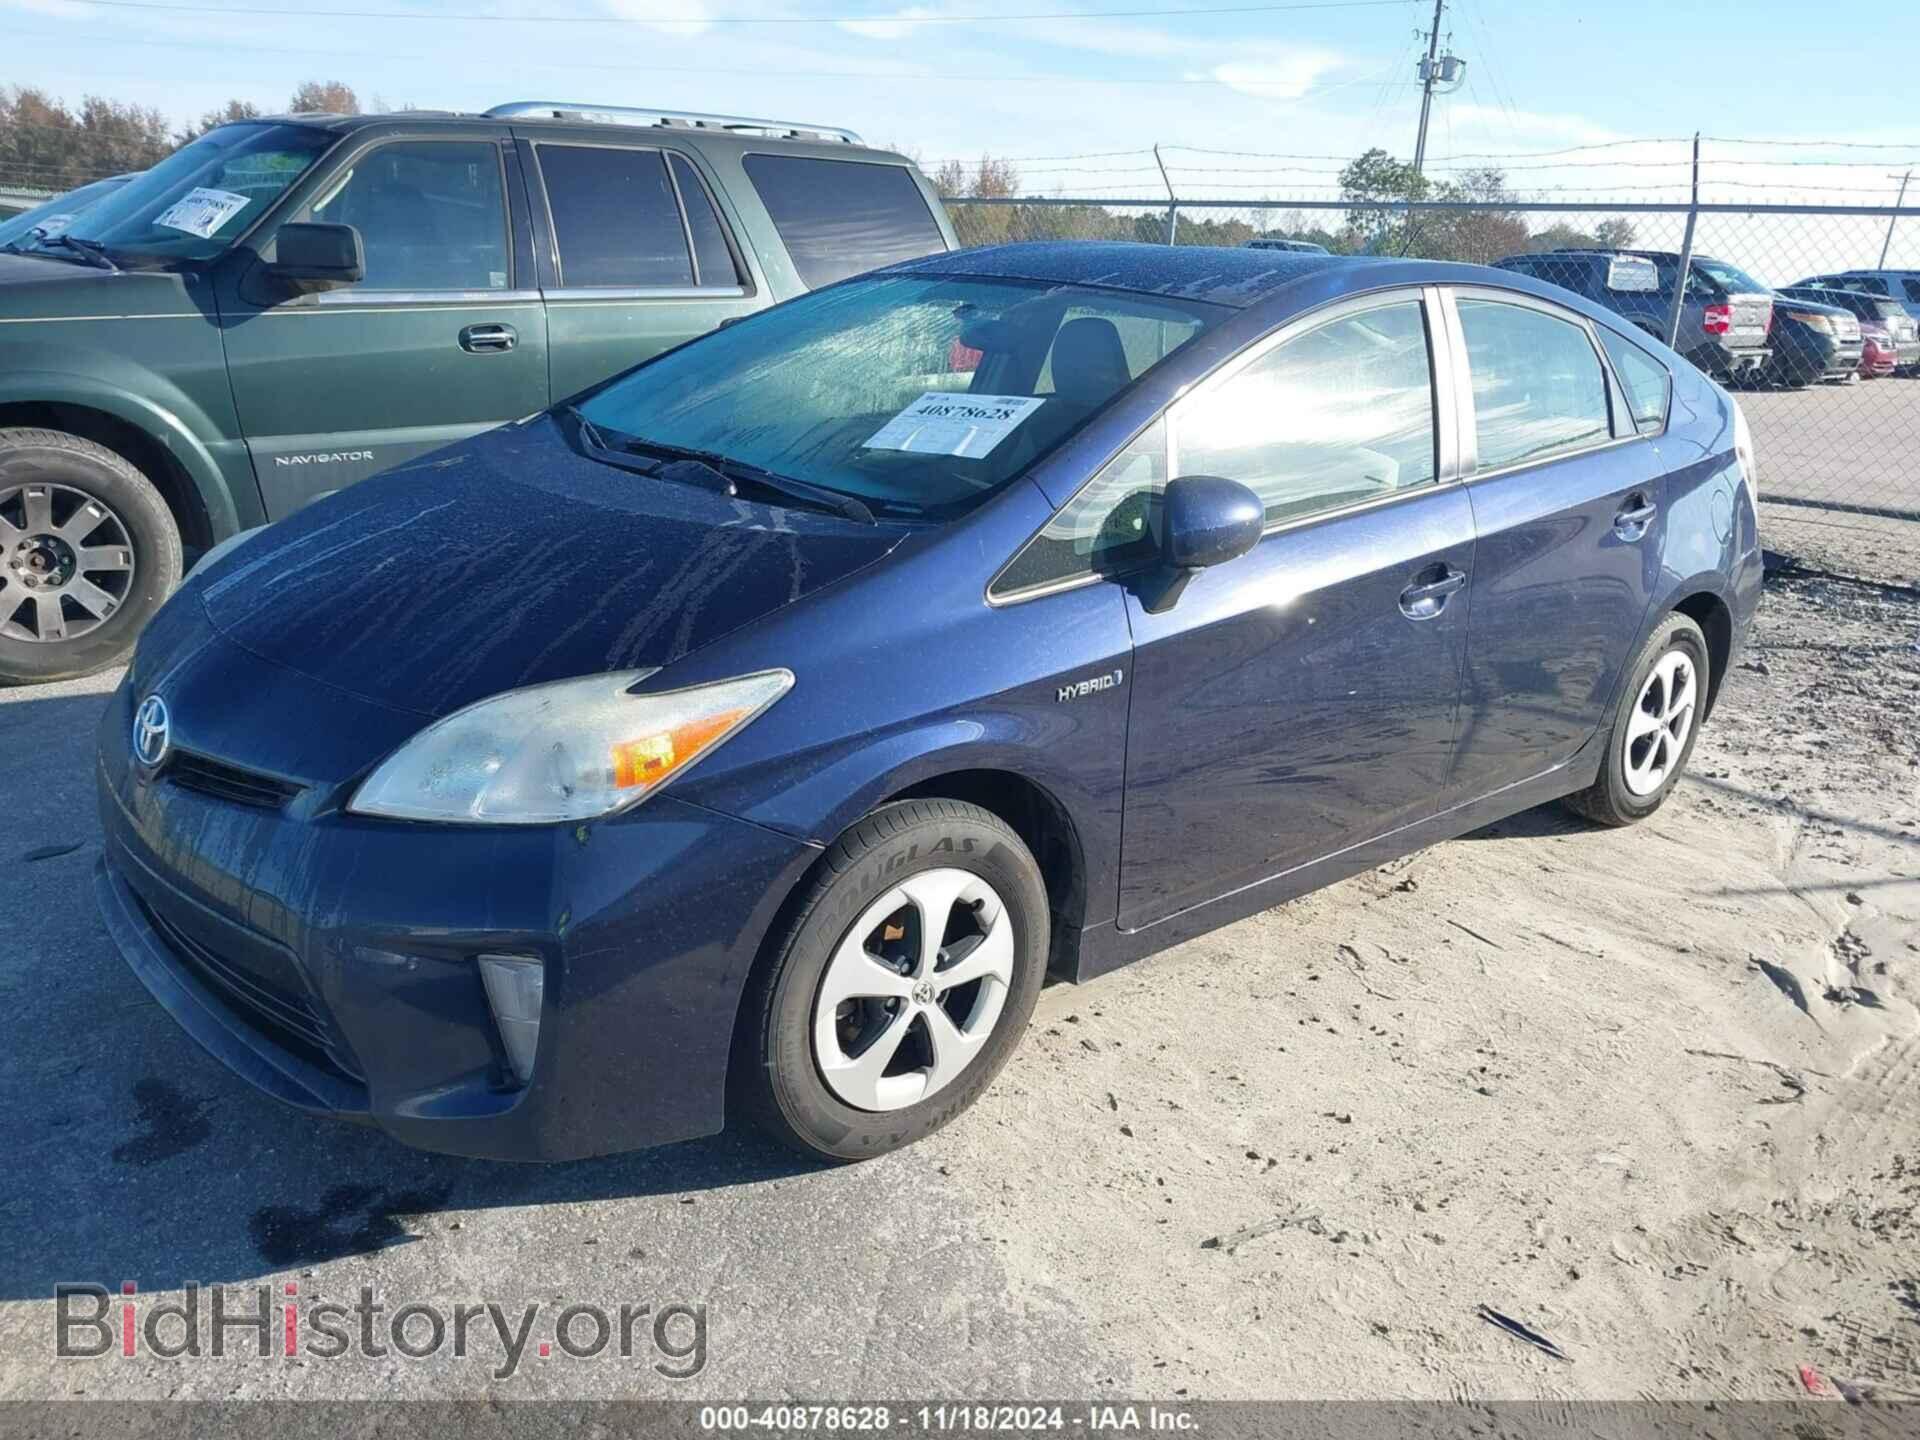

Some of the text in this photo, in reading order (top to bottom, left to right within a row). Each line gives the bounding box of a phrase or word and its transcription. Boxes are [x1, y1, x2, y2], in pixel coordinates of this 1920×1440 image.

[917, 403, 1016, 420] 40878628
[274, 450, 375, 467] NAVIGATOR
[1058, 674, 1115, 702] HYBRID
